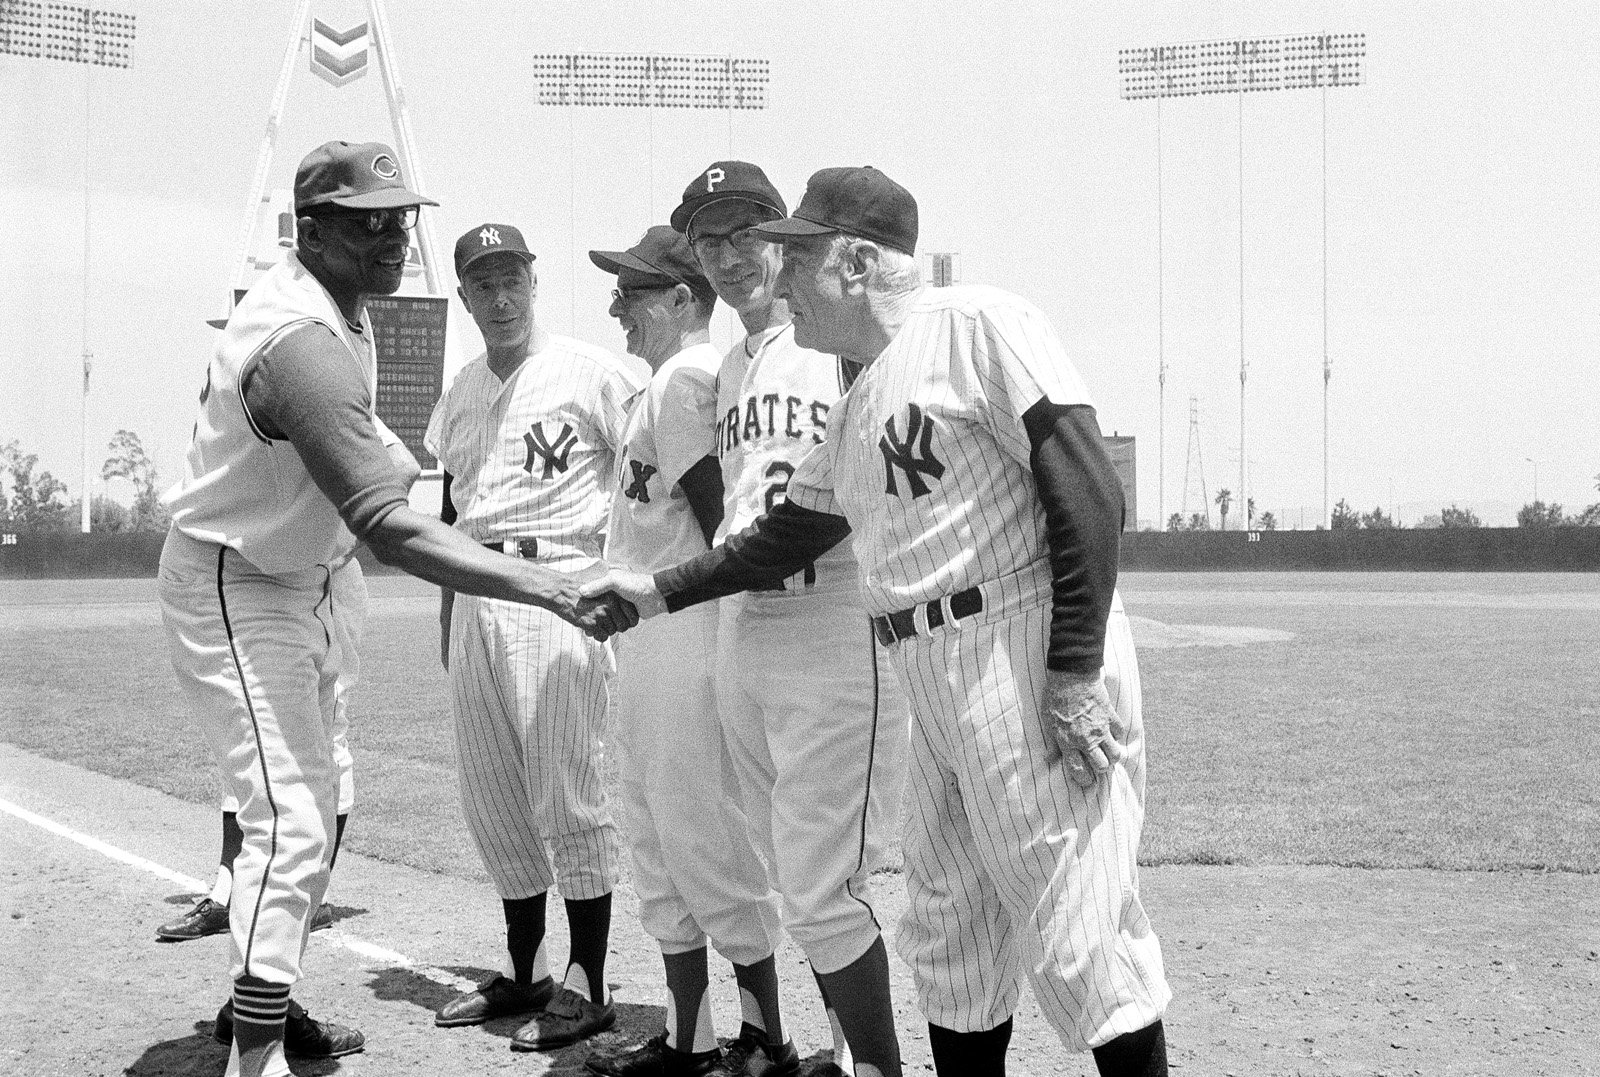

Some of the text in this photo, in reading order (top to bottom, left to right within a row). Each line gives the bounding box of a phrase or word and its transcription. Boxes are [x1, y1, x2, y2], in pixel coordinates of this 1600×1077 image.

[371, 153, 398, 180] C
[707, 167, 725, 192] P
[479, 227, 502, 247] NY
[523, 420, 578, 480] NY
[878, 402, 946, 500] NY
